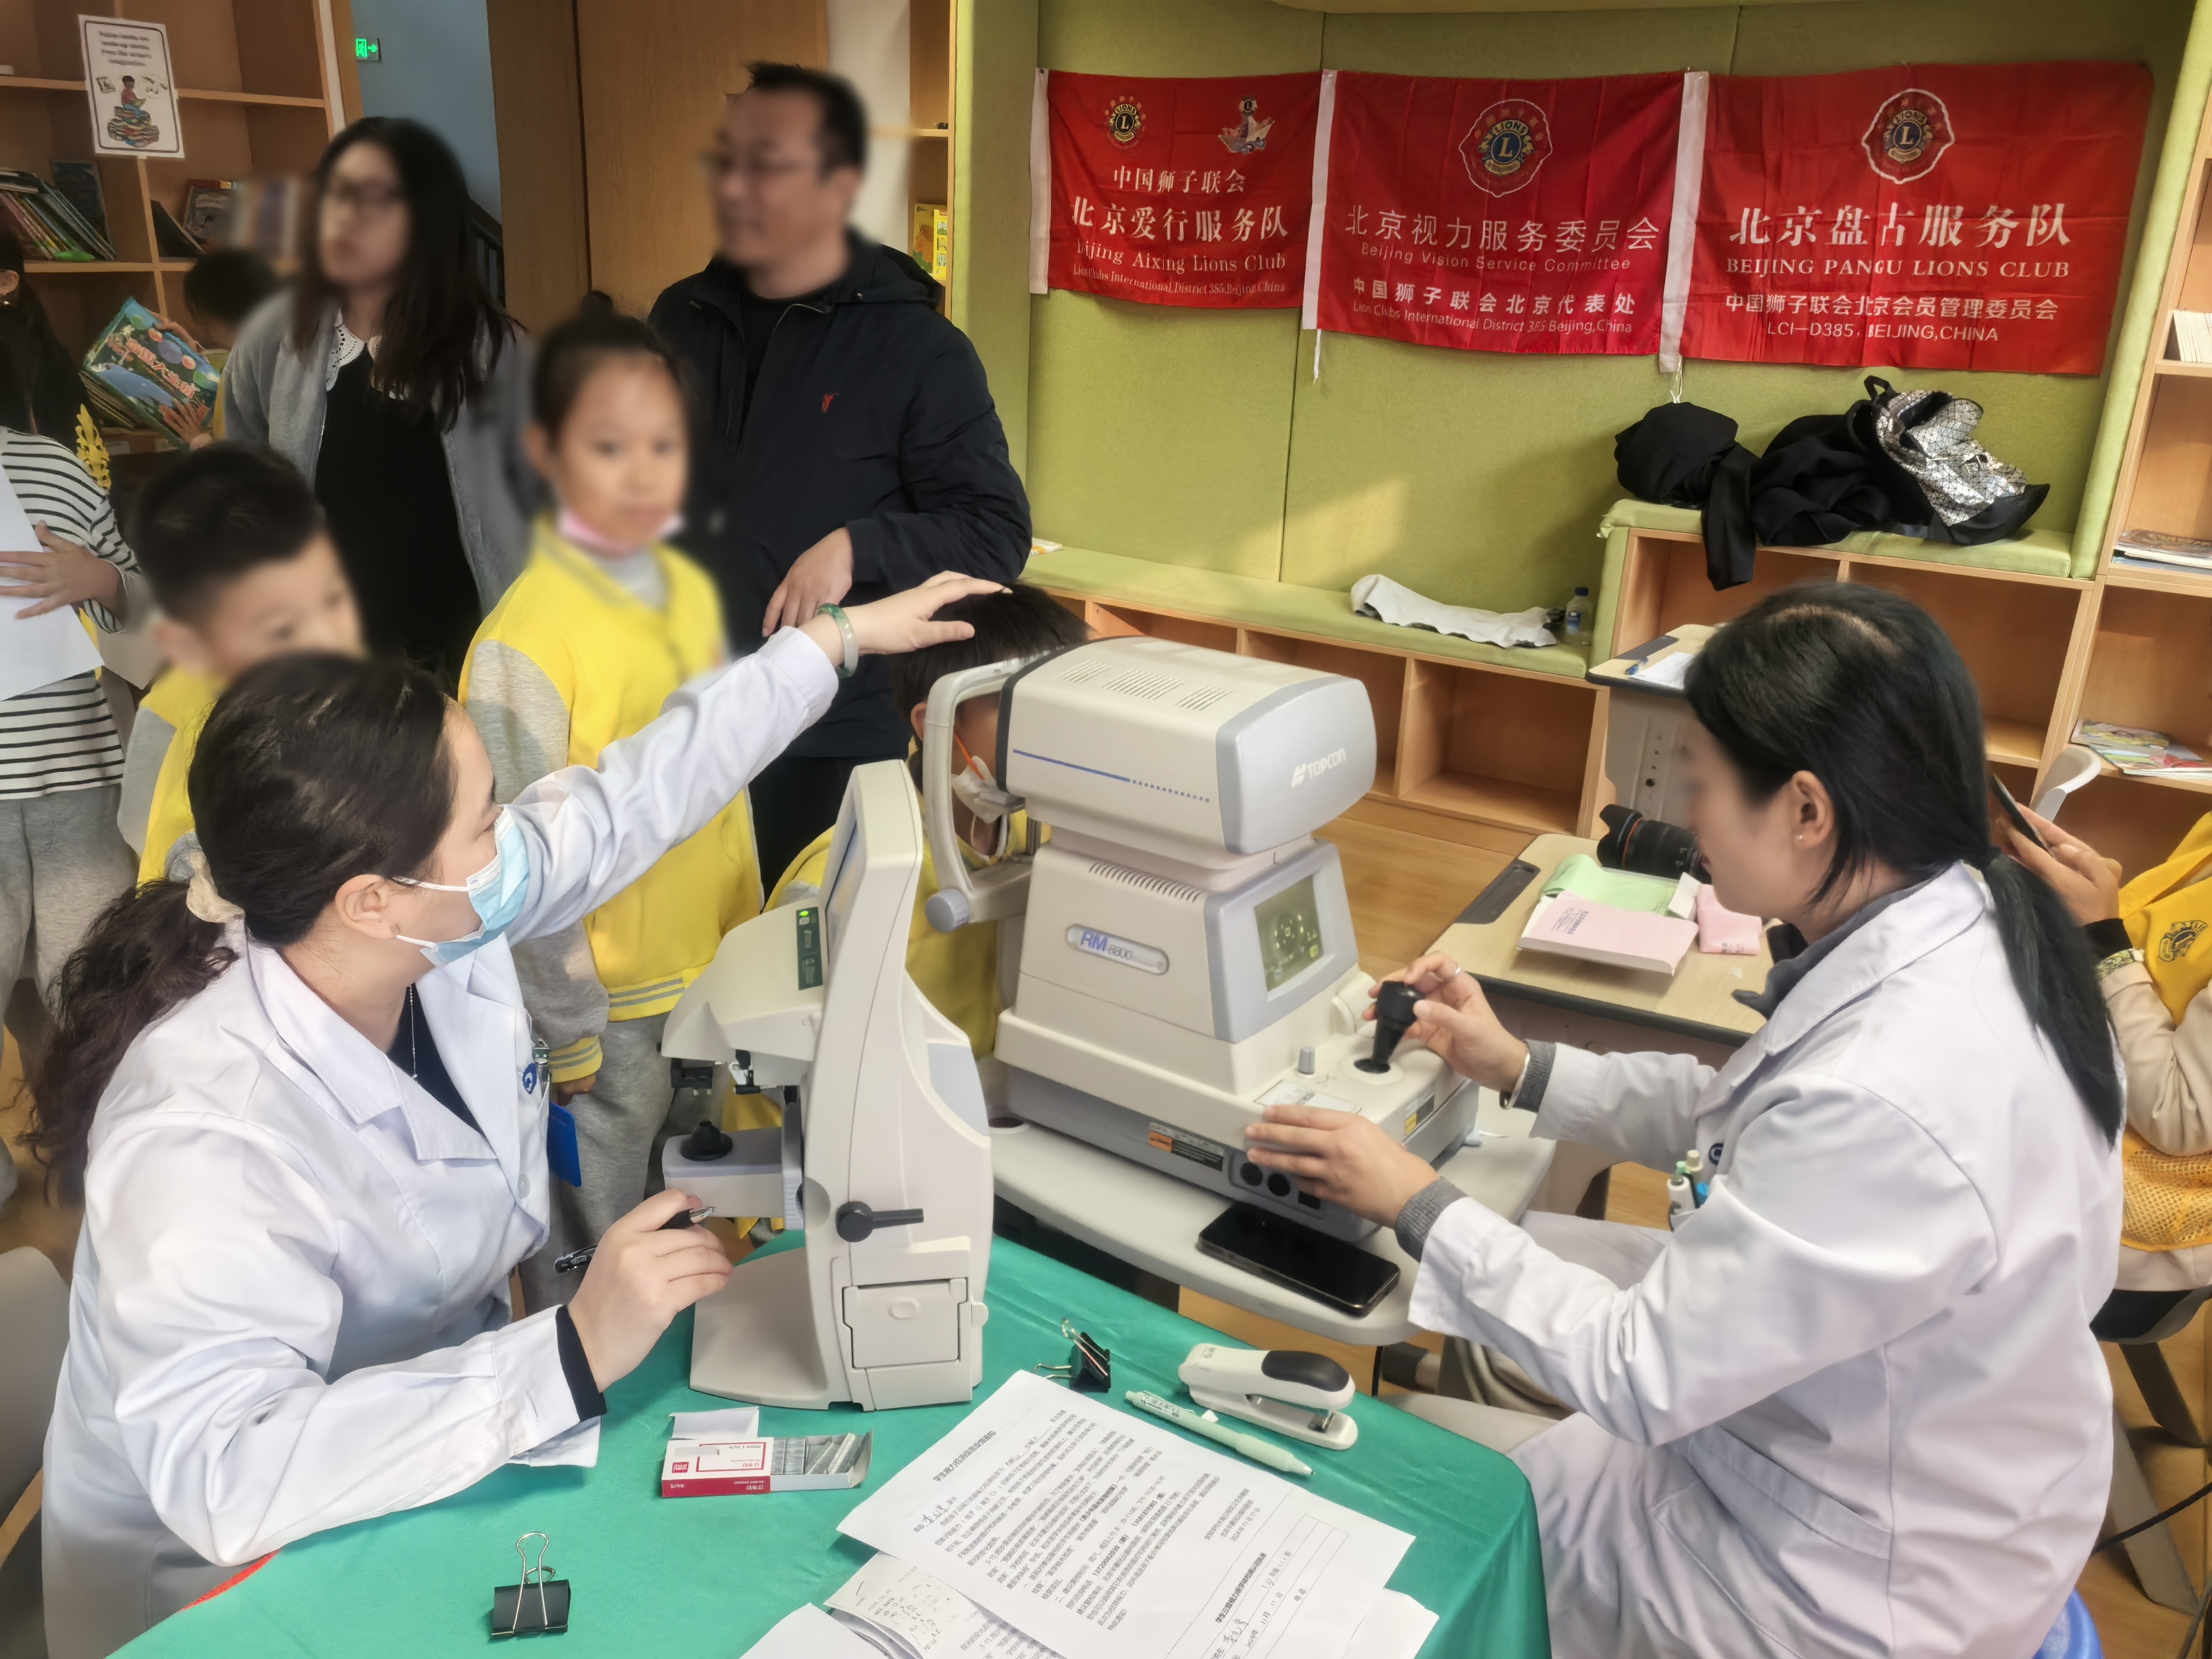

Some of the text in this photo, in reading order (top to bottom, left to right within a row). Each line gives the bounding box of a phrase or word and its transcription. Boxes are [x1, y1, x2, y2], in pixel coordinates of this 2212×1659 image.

[1494, 122, 1527, 134] LIONS
[1114, 165, 1245, 193] 中国狮子联会
[1071, 196, 1288, 242] 北京爱行服务队
[1345, 205, 1659, 252] 北京视力服务委员会
[1193, 255, 1237, 272] Lions
[1245, 253, 1285, 272] Club
[1362, 242, 1630, 272] Beijing Vision Service Committee
[1727, 259, 2069, 278] BEIJING PANGU LIONS CLUB
[1354, 277, 1635, 314] 中国狮子联会北京代表处
[1726, 292, 2059, 320] 中国狮子联会北京会员管理委员会
[1404, 309, 1479, 329] International
[1483, 319, 1524, 331] District
[1527, 321, 1545, 332] 385
